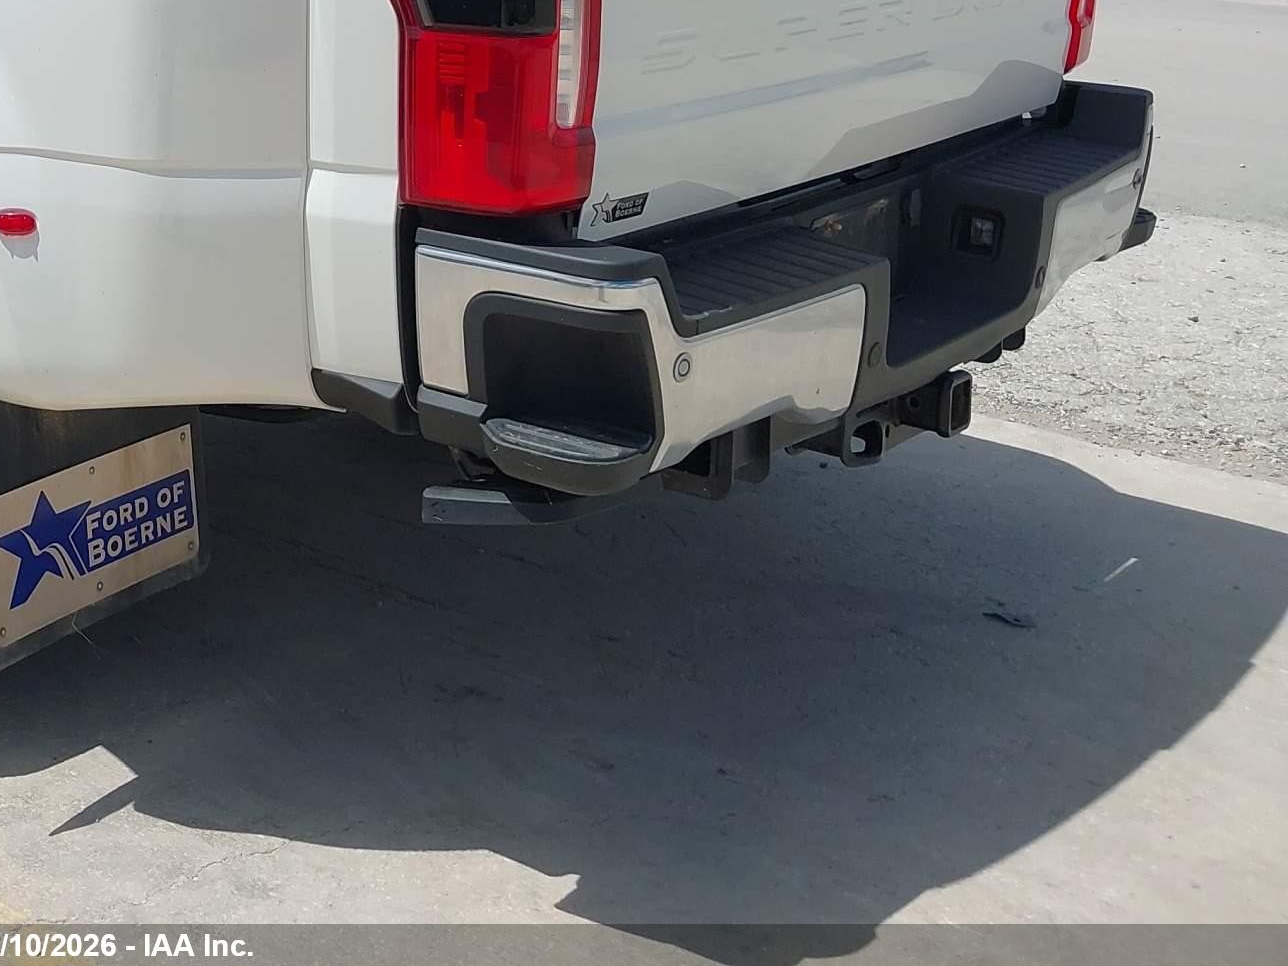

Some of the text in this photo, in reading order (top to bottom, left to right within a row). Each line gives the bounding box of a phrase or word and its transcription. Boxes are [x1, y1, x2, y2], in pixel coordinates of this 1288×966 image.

[86, 481, 185, 539] FORD OF
[87, 506, 188, 567] BOERNE
